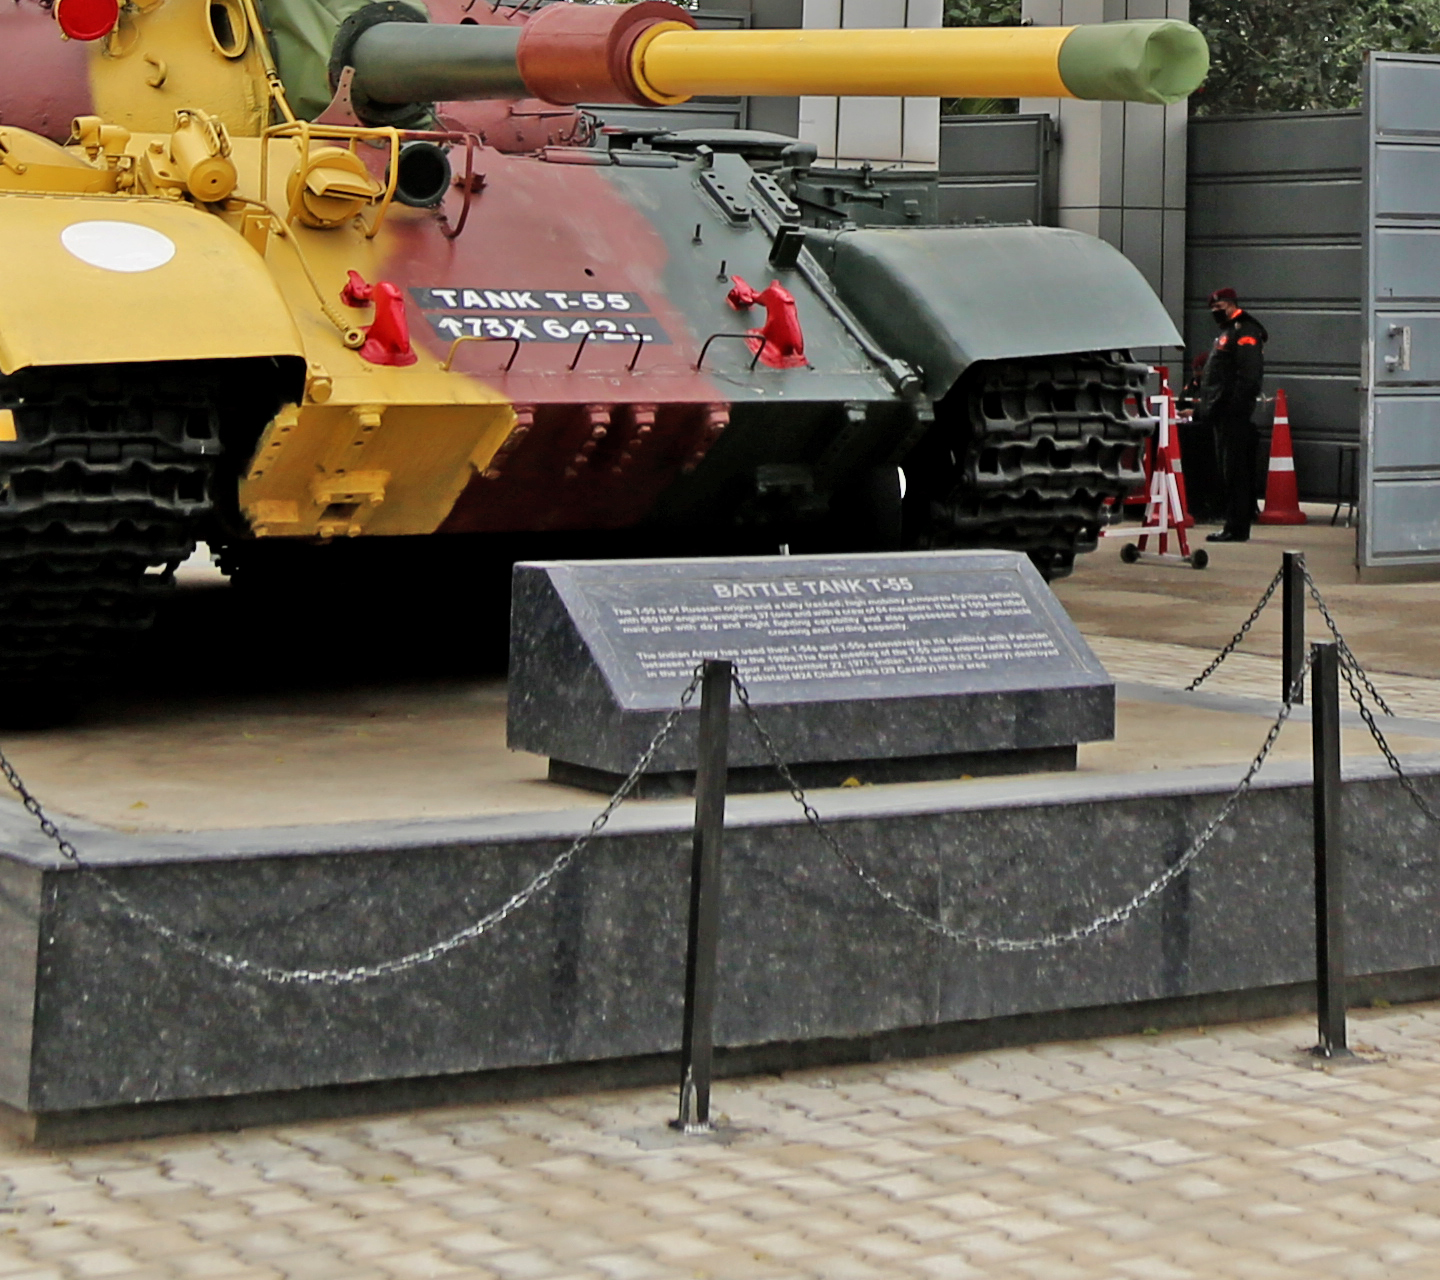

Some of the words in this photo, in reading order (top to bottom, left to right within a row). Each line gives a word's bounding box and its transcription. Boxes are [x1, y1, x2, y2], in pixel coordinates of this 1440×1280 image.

[431, 289, 542, 310] TANK
[544, 291, 631, 311] T-55
[712, 582, 802, 598] BATTLE
[803, 579, 867, 596] TANK
[866, 577, 914, 593] T-55
[613, 605, 632, 616] The
[681, 605, 722, 613] Russian
[723, 604, 752, 613] origin
[722, 622, 741, 630] and
[864, 615, 881, 623] and
[811, 627, 830, 635] and
[636, 651, 657, 660] The
[657, 650, 691, 659] Indian
[692, 649, 718, 658] Army
[719, 648, 739, 656] has
[741, 646, 765, 655] used
[819, 643, 838, 651] and
[987, 633, 1009, 641] with
[1009, 632, 1049, 640] Pakistan
[641, 660, 685, 669] between
[778, 662, 828, 671] November
[874, 656, 905, 665] Indian
[928, 653, 956, 662] tanks
[851, 667, 880, 676] tanks
